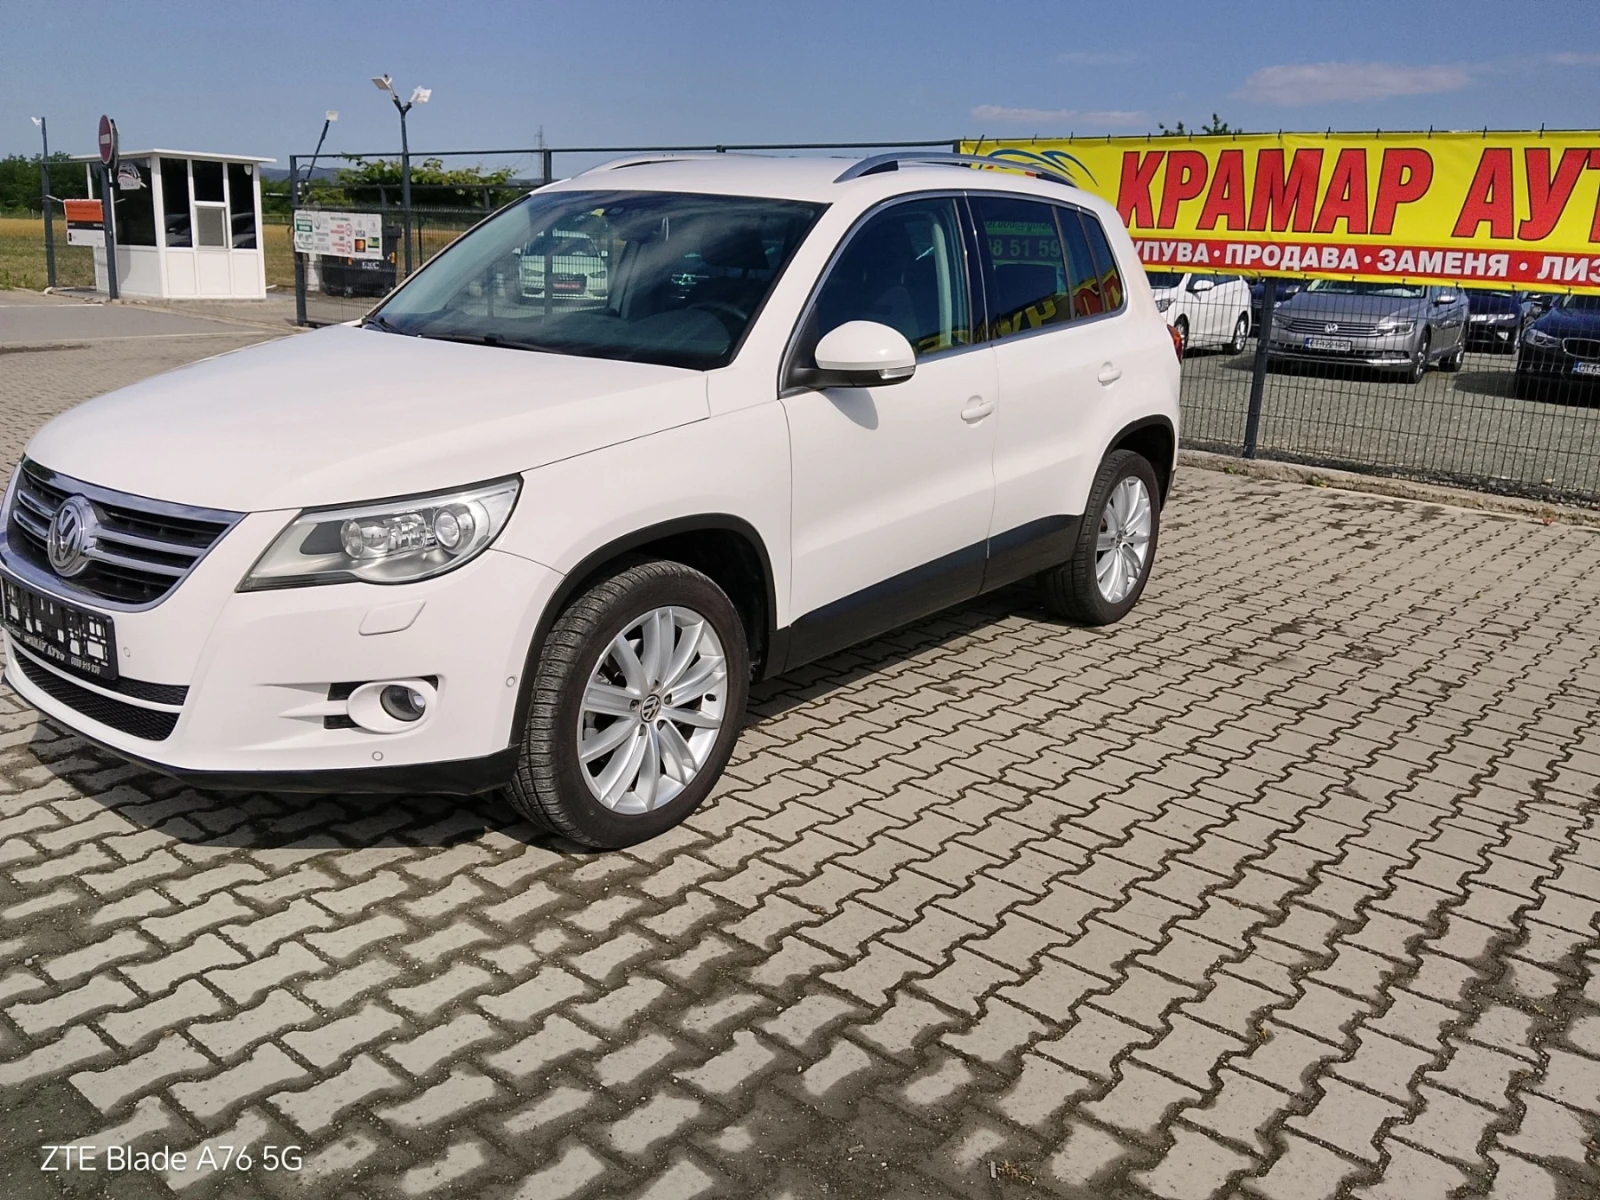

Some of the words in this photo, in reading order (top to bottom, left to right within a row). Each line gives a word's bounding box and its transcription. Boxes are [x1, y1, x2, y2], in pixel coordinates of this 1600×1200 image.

[1116, 148, 1434, 236] КРАМАР
[1010, 240, 1030, 256] 51
[1224, 244, 1359, 271] ПРОДАВА
[1376, 248, 1509, 277] ЗАМЕНЯ
